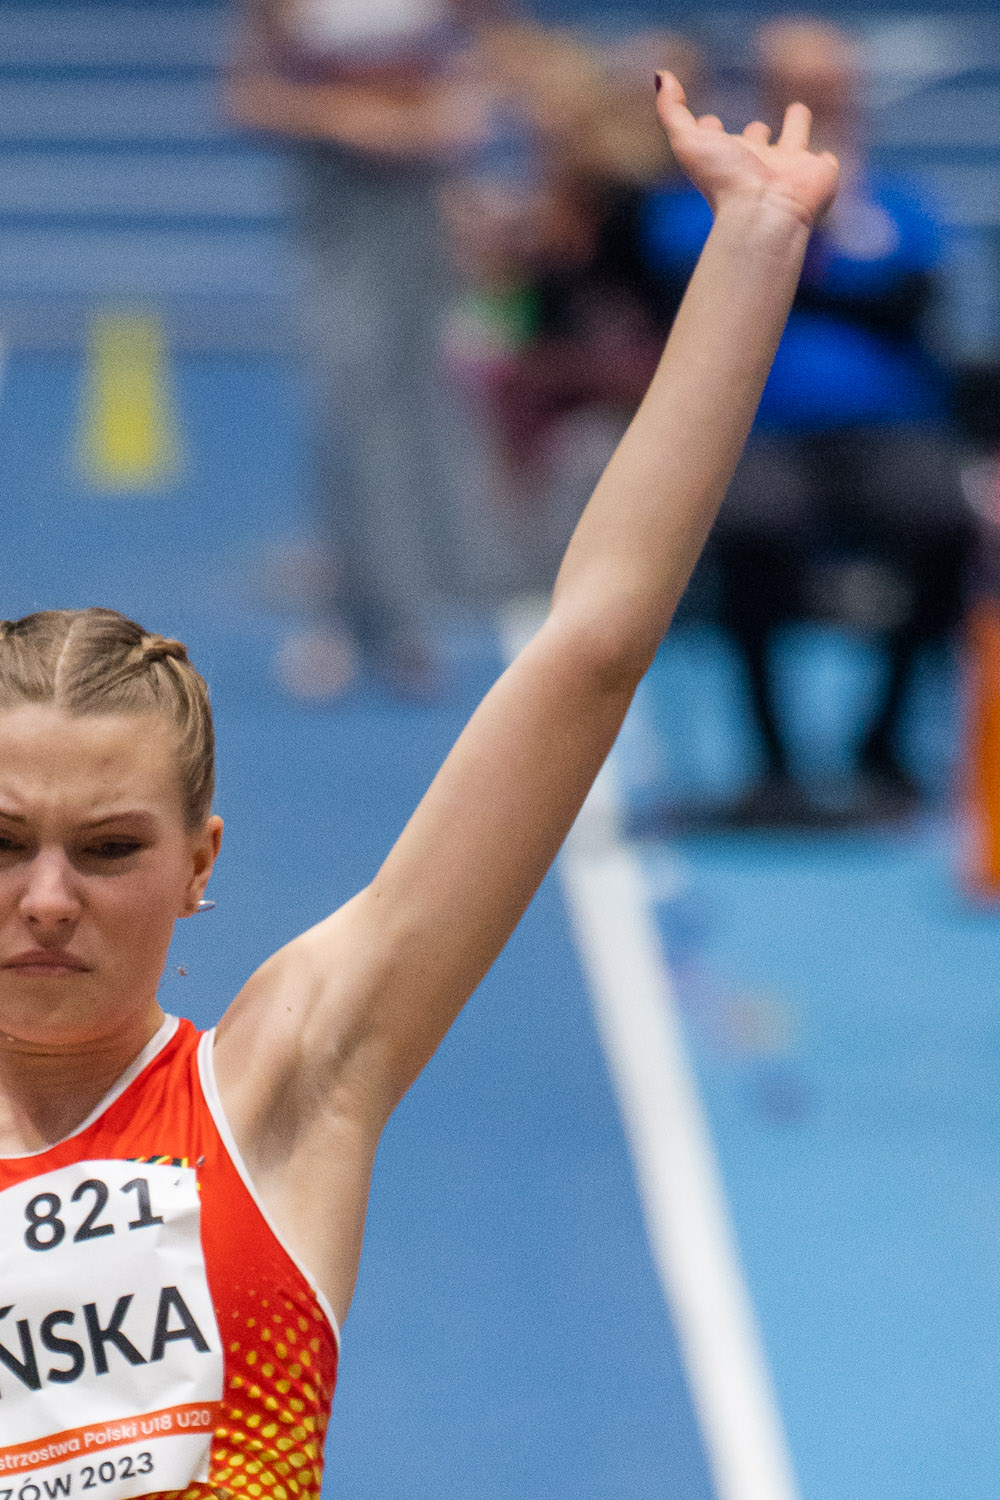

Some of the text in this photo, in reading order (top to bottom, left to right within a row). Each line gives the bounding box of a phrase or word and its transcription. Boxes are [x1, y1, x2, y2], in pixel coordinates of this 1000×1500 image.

[24, 1177, 165, 1252] 821
[84, 1422, 138, 1448] Polski
[141, 1413, 173, 1435] U18
[176, 1409, 212, 1428] U20
[80, 1451, 155, 1490] 2023
